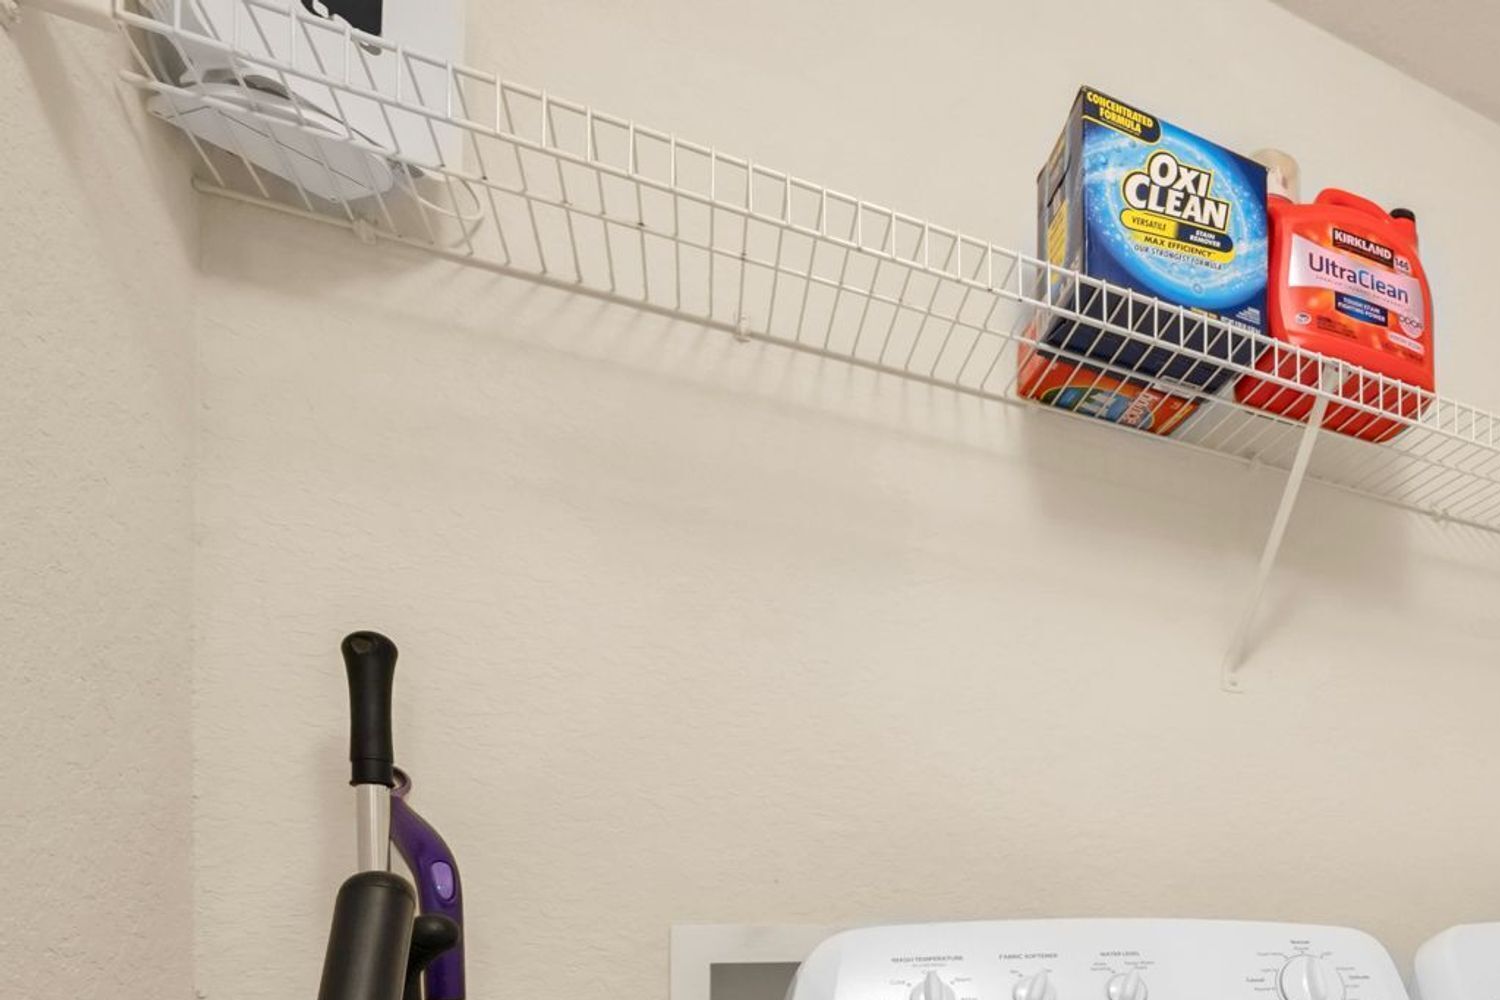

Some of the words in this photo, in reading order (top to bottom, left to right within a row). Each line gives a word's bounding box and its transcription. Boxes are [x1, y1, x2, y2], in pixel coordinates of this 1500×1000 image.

[1087, 91, 1154, 128] CONCENTRATED
[1099, 107, 1142, 133] FORMULA
[1148, 152, 1211, 198] OXI
[1123, 172, 1229, 230] CLEAN
[1132, 217, 1168, 230] VERSATILE
[1144, 235, 1166, 248] MAX
[1167, 241, 1212, 258] EFFICIENCY
[1334, 229, 1392, 260] KIRKLAND
[1309, 252, 1409, 304] UltraClean
